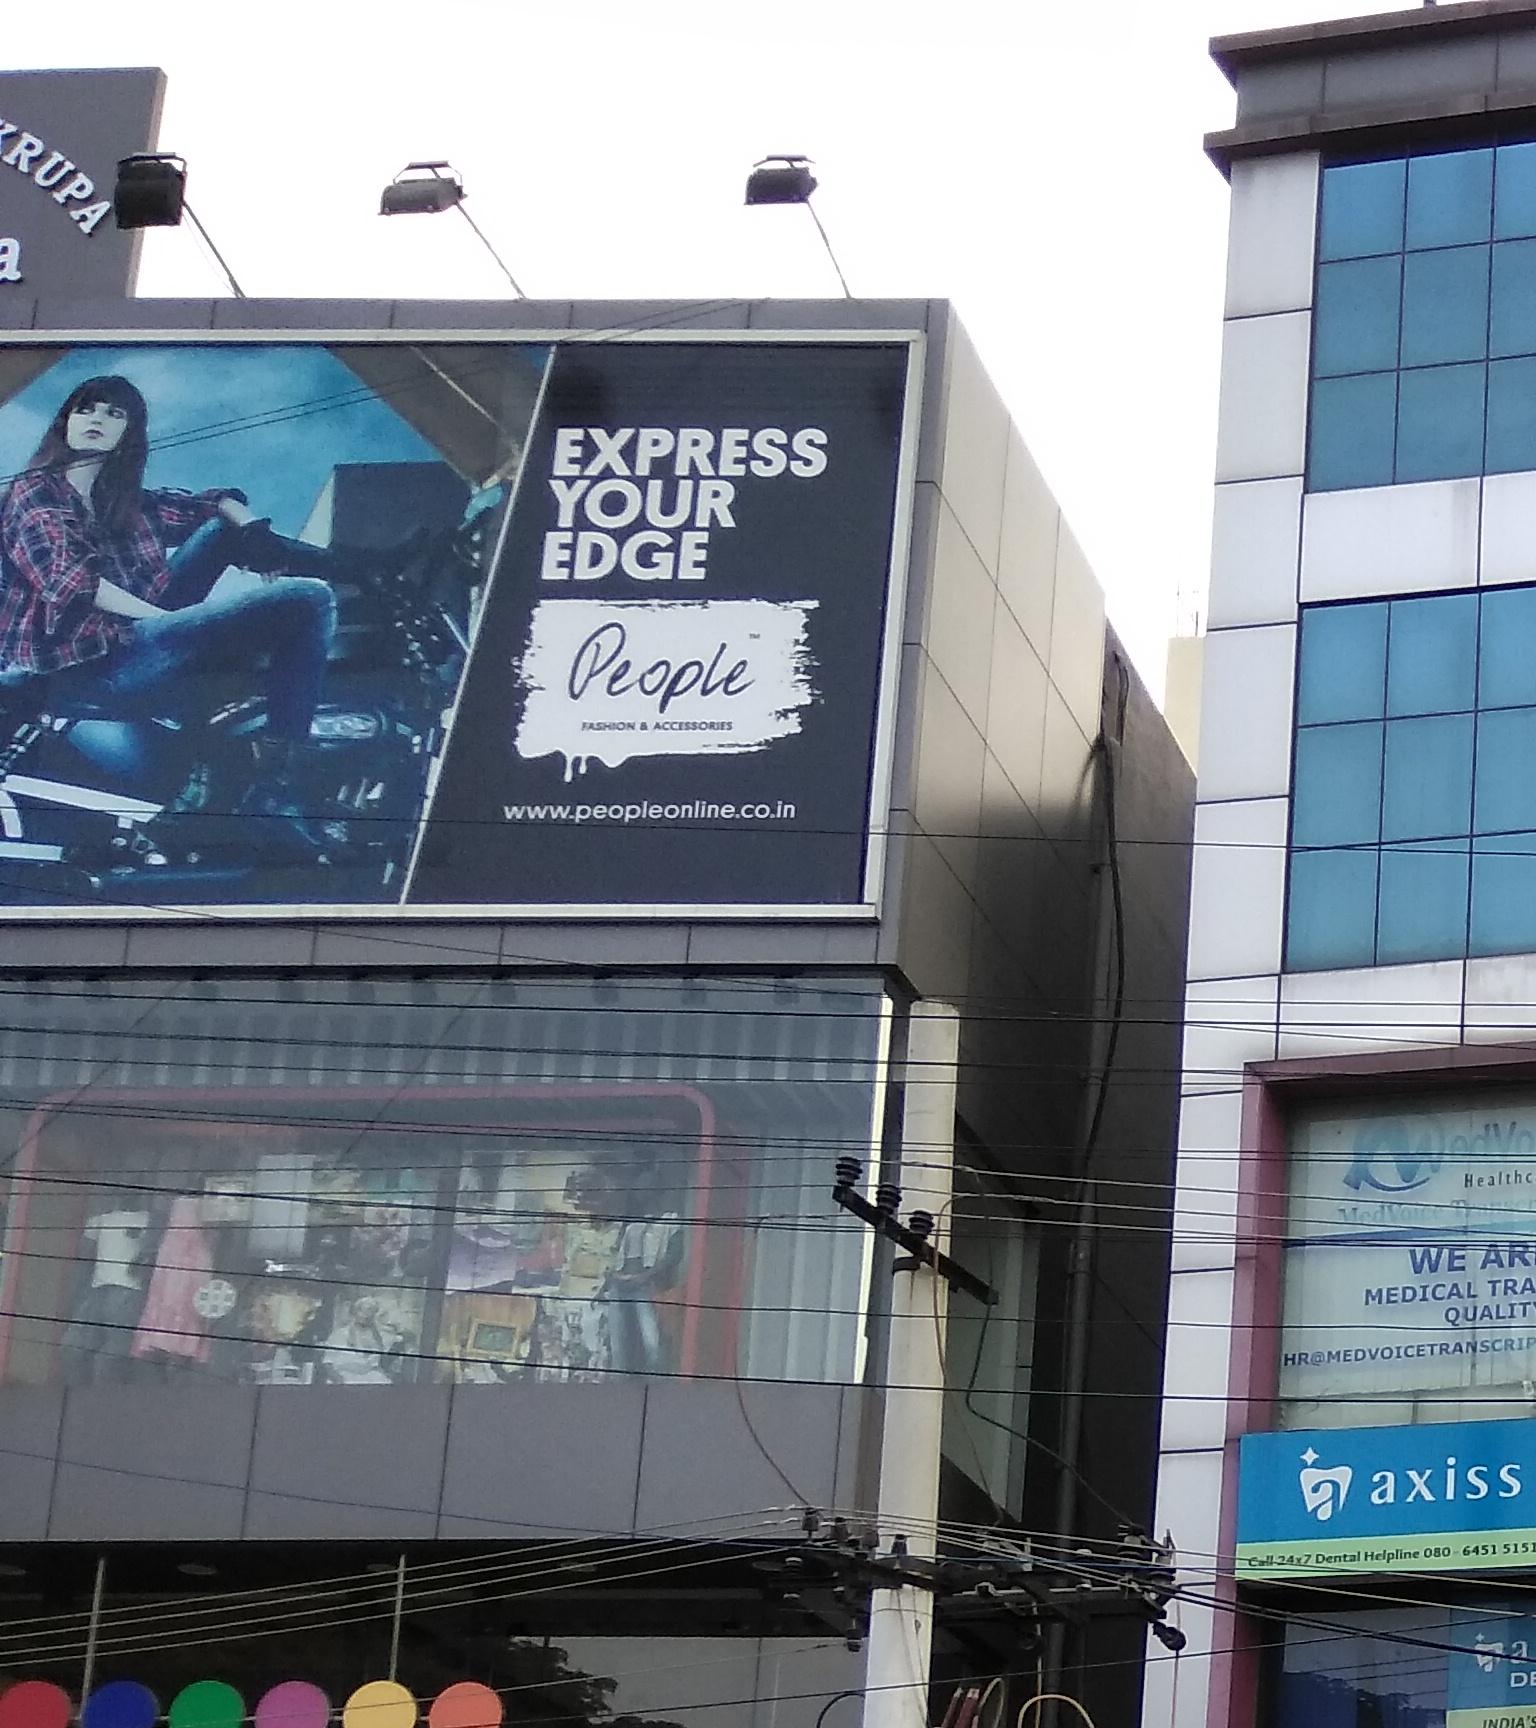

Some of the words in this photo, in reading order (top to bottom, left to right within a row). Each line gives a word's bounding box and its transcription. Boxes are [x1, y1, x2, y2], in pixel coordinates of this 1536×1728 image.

[552, 427, 829, 478] EXPRESS
[548, 478, 737, 528] YOUR
[541, 530, 710, 580] EDGE
[568, 621, 755, 714] People
[581, 721, 636, 731] FASHION
[640, 721, 648, 731] &
[653, 720, 734, 731] ACCESSORIES
[504, 801, 796, 824] www.peopleonline.co.in
[1408, 1246, 1467, 1276] WE
[1364, 1281, 1478, 1307] MEDICAL
[1370, 1456, 1523, 1505] axiss
[1315, 1550, 1361, 1564] Dental
[1364, 1547, 1420, 1563] Helpline
[1423, 1547, 1451, 1558] 080
[1462, 1544, 1498, 1556] 6451
